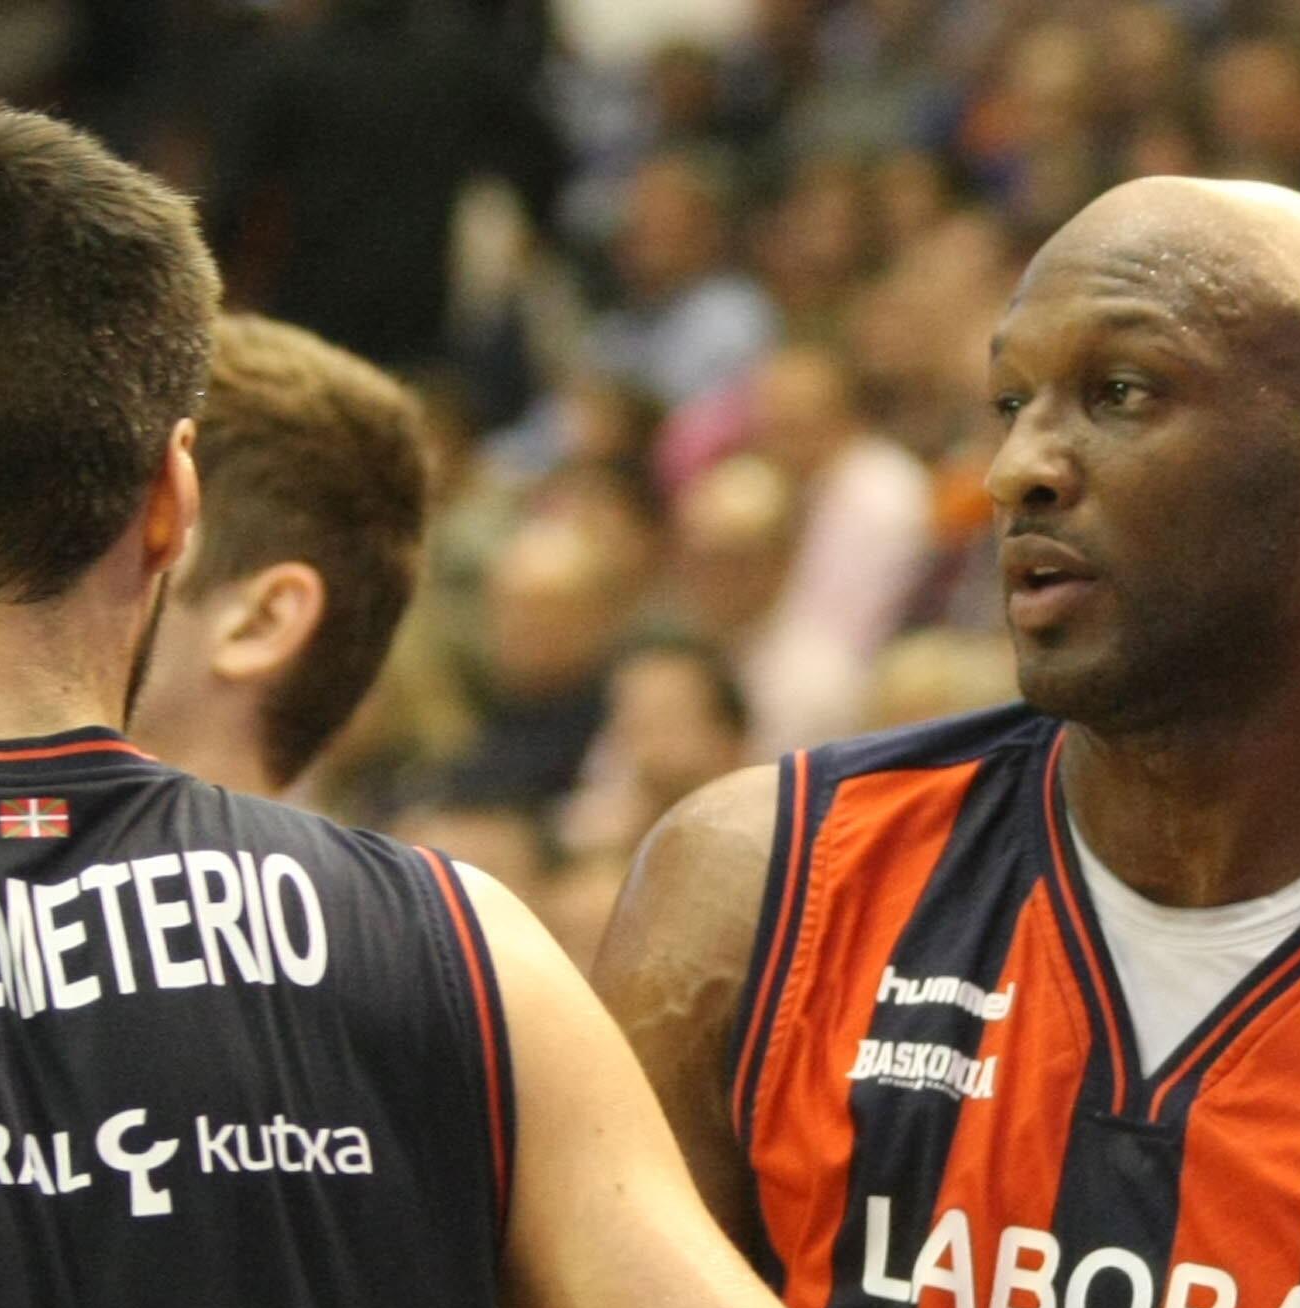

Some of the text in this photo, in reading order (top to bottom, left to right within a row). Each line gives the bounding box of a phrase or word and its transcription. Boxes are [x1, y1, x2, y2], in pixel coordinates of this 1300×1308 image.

[875, 964, 1016, 1021] hummel
[845, 1038, 998, 1099] BASKONIA
[196, 1114, 374, 1175] kutxa
